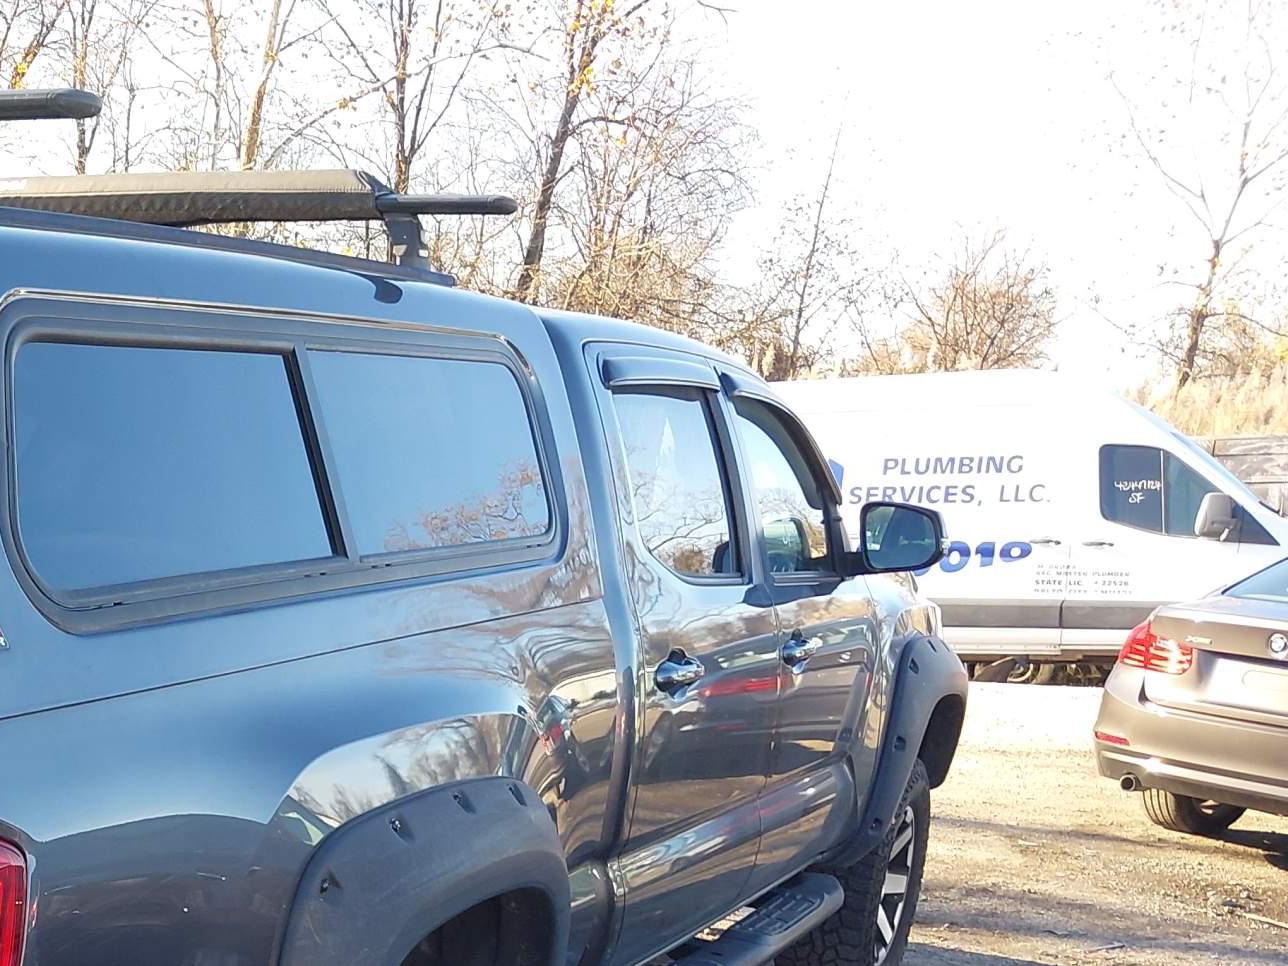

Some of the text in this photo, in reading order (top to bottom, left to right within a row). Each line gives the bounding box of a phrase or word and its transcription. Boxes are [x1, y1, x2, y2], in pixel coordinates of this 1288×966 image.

[883, 455, 1024, 475] PLUMBING
[849, 484, 1051, 506] SERVICES, LLC.
[914, 541, 1033, 577] 010
